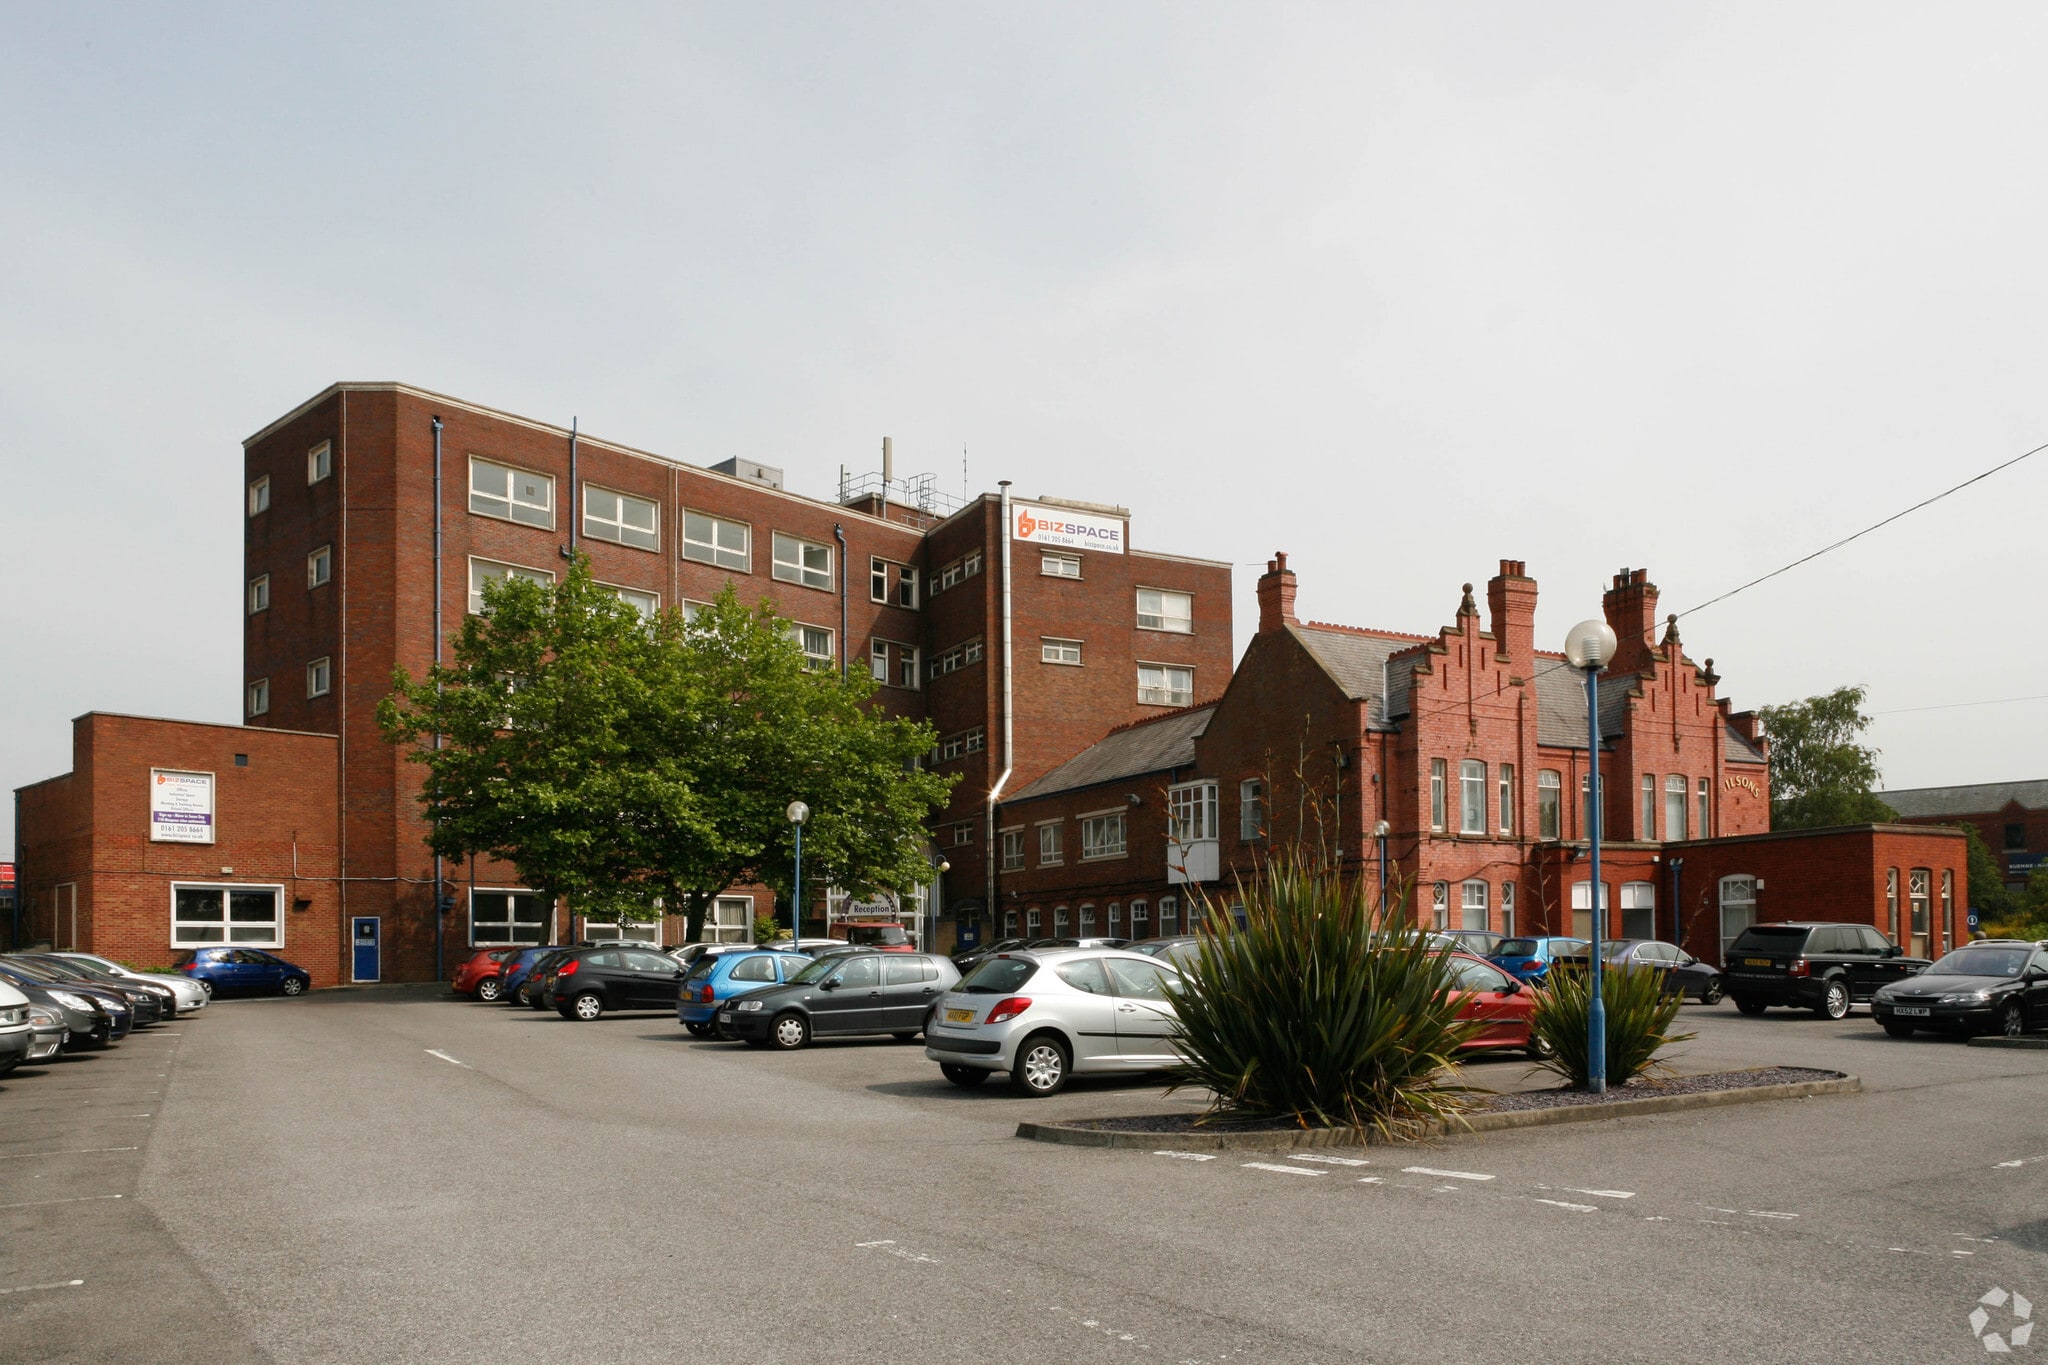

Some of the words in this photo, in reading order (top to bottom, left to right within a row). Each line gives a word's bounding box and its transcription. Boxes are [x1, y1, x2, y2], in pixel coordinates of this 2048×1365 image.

[1038, 519, 1119, 541] BIZSPACE
[166, 777, 207, 785] BIZSPACE
[1724, 776, 1761, 798] ILSONS
[854, 904, 890, 915] Reception
